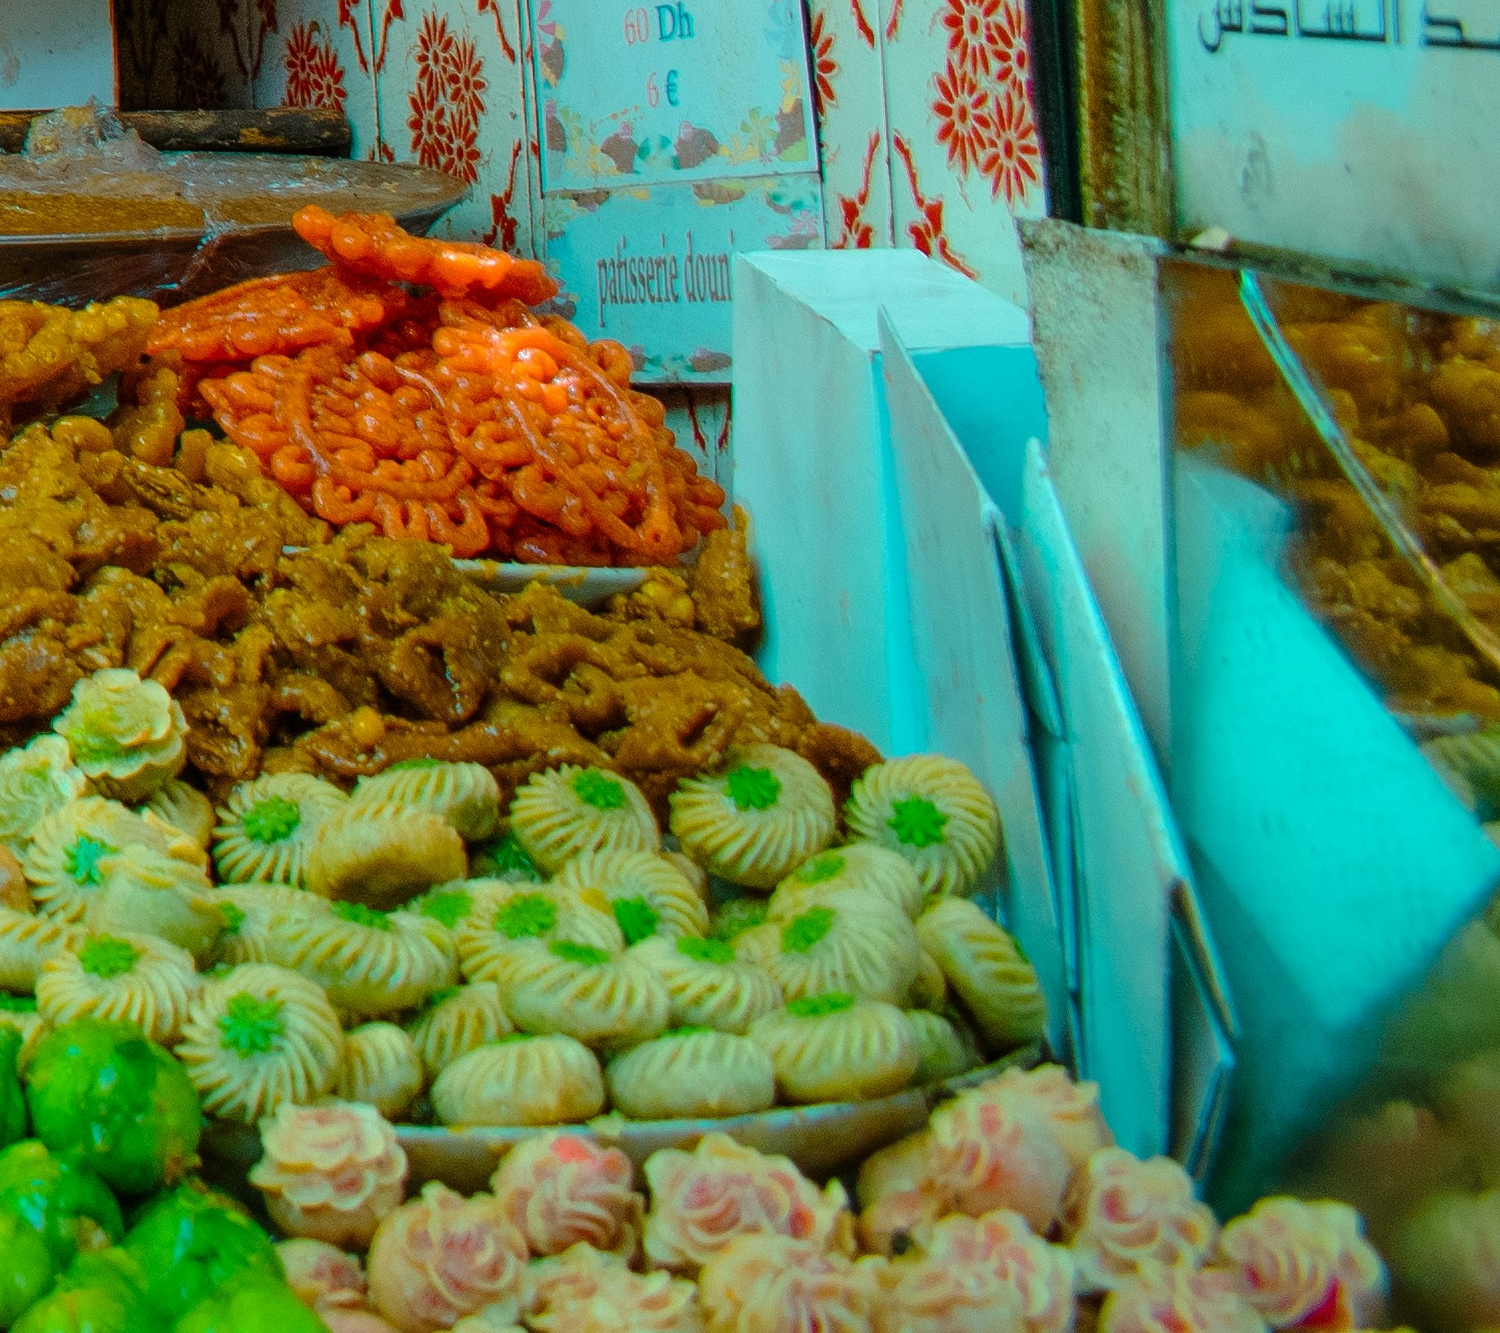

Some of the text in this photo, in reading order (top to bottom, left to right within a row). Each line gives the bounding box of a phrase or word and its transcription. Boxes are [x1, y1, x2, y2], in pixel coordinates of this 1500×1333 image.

[623, 0, 696, 47] 60 Dh
[646, 69, 680, 109] 6 €
[596, 229, 735, 328] patisserie doun
